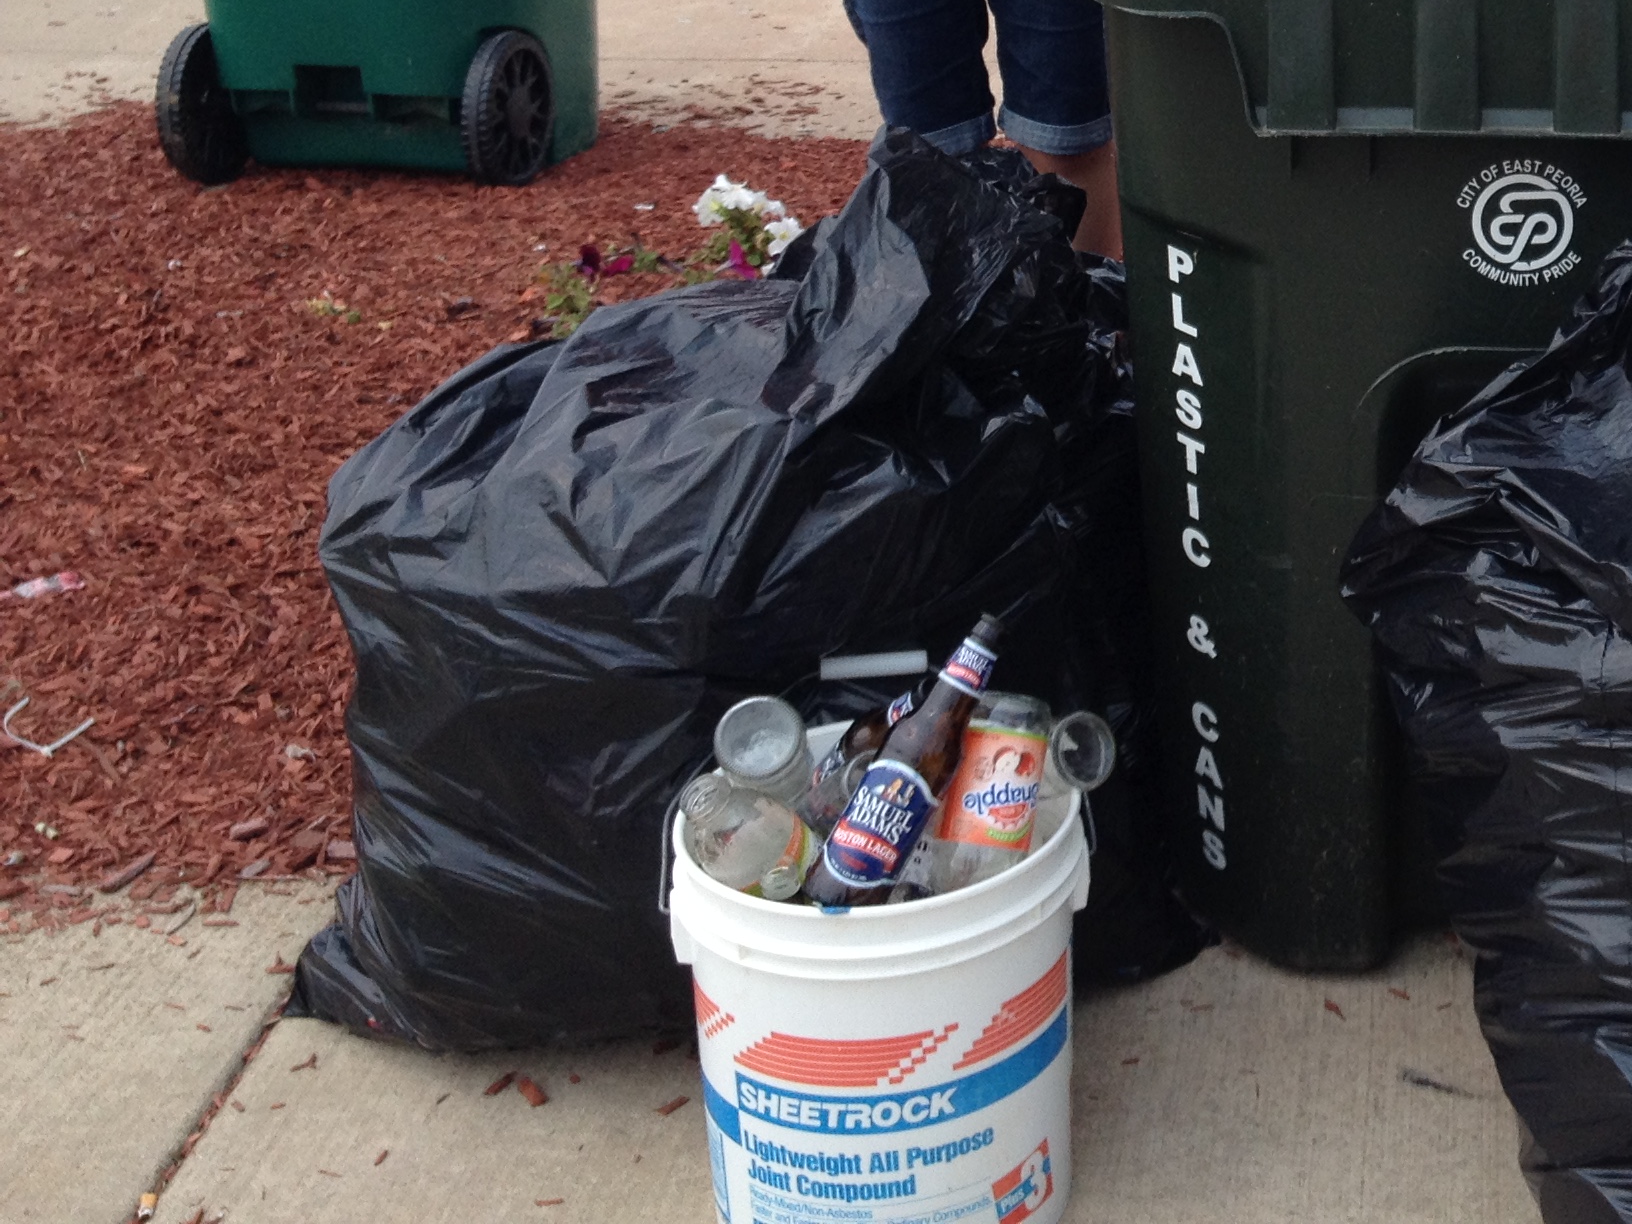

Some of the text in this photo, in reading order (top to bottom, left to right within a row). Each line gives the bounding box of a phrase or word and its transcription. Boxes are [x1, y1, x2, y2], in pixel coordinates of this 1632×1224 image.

[1456, 159, 1588, 209] CITY OF EAST PEORIA
[1462, 248, 1582, 287] COMMUNITY PRIDE
[1166, 244, 1228, 871] PLASTIC & CANS
[847, 806, 902, 846] ADAMS
[853, 785, 914, 834] SAMUEL
[866, 840, 898, 863] LAGER
[739, 1084, 957, 1130] SHEETROCK
[743, 1127, 995, 1176] Lightweight All Purpose
[748, 1158, 917, 1203] Joint Compound
